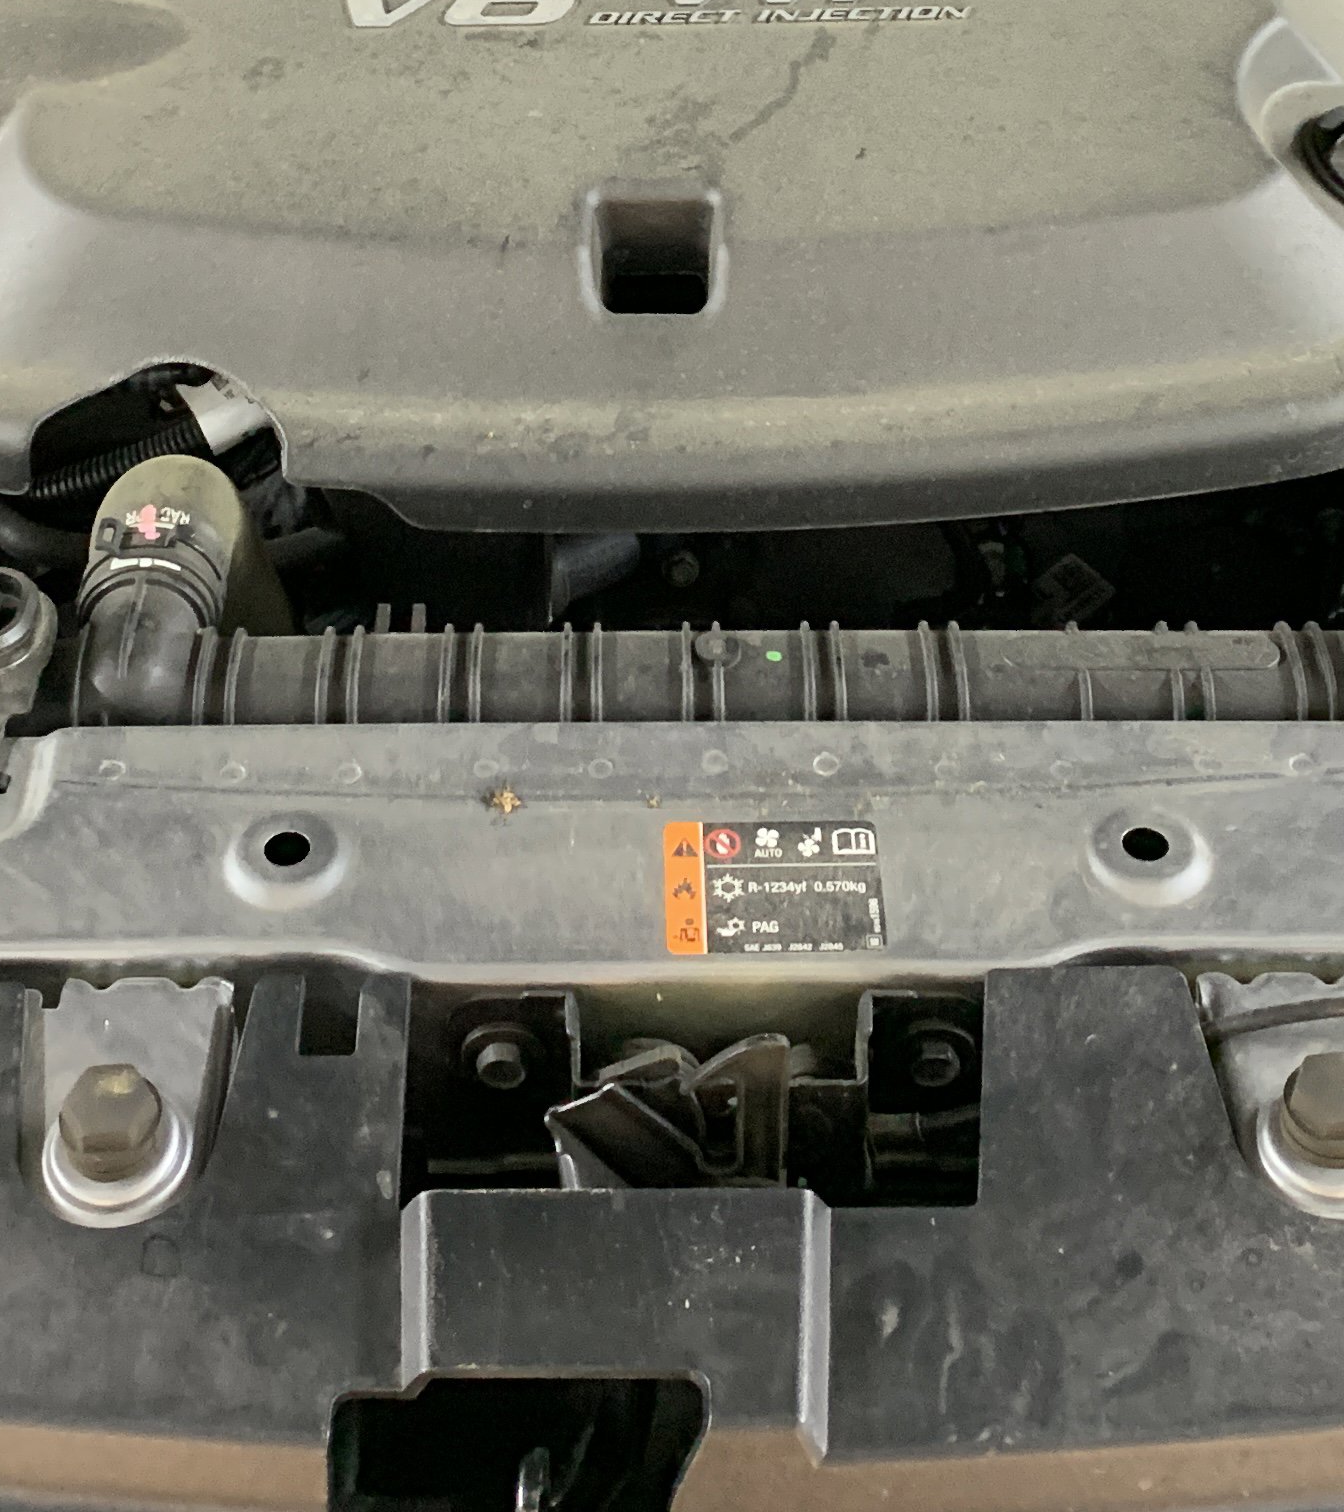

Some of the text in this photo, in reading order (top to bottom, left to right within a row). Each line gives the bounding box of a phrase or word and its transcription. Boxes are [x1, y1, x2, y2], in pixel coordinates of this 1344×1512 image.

[588, 5, 973, 26] DIRECT INJECTION
[754, 848, 783, 859] AUTO
[747, 881, 807, 895] R-1234yf
[751, 920, 779, 934] PAG
